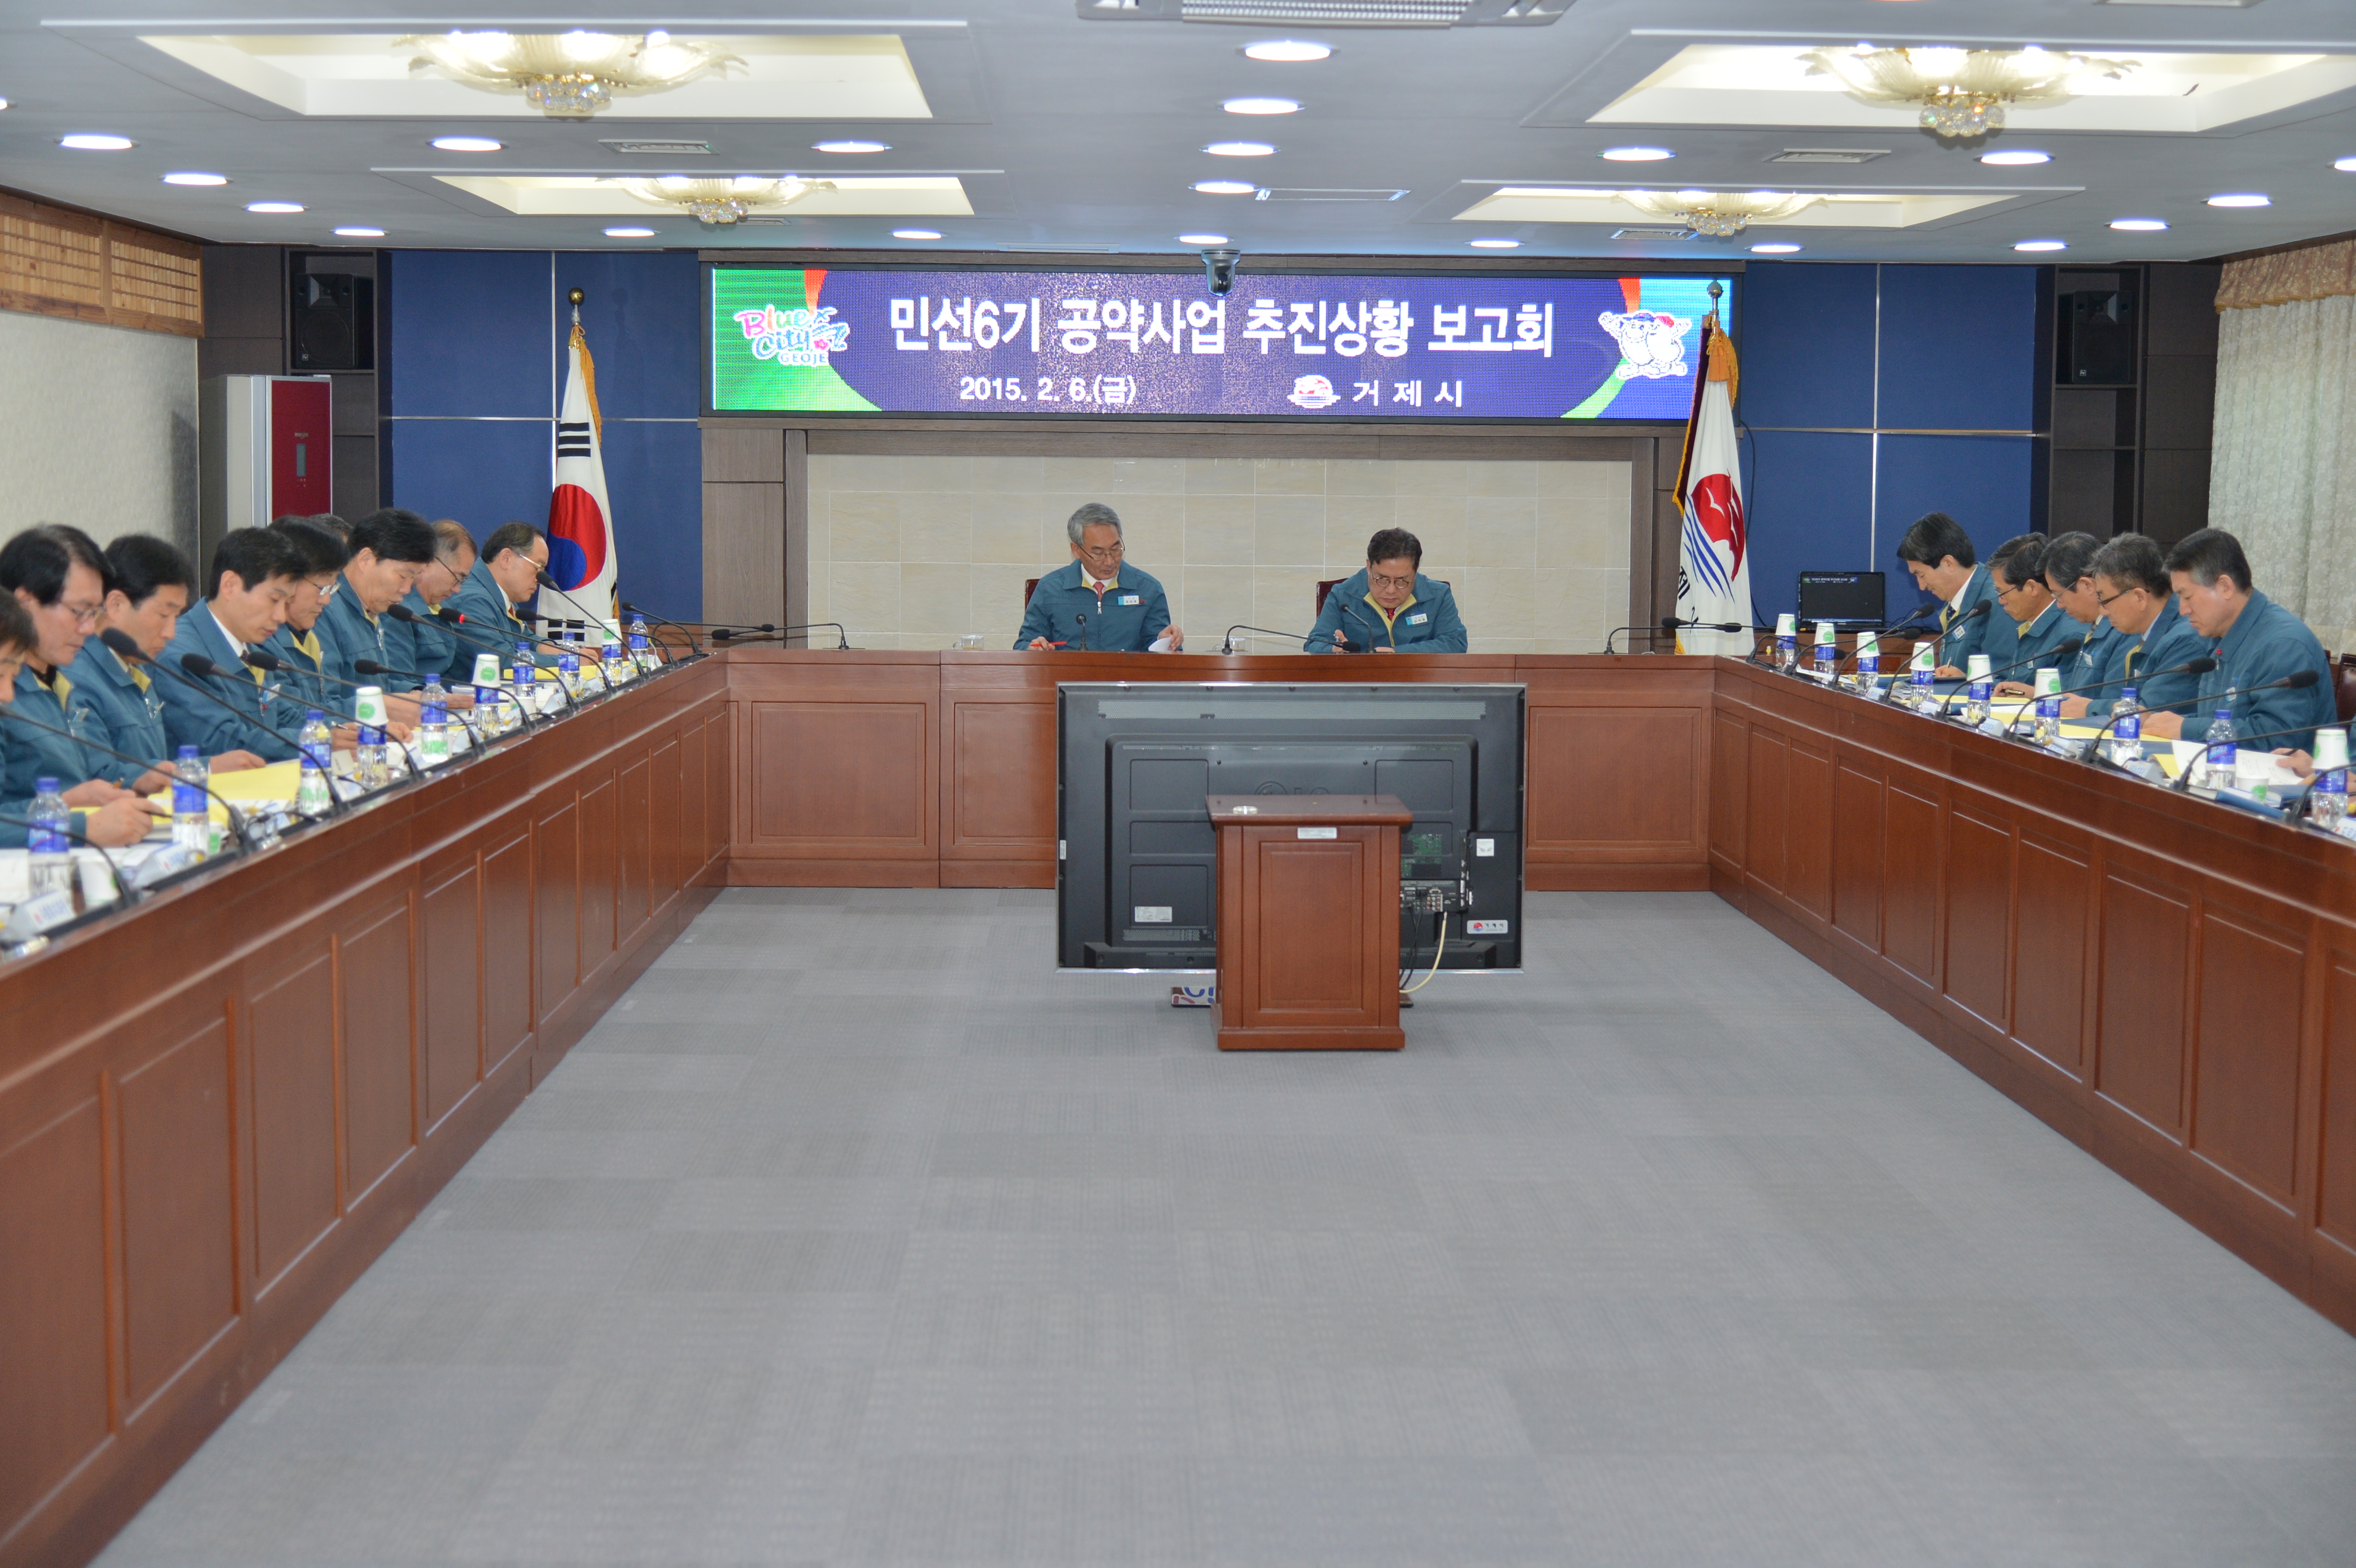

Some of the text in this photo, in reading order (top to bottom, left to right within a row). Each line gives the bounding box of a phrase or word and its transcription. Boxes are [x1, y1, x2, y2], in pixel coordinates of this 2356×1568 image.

[734, 305, 812, 338] Blue
[891, 296, 1552, 358] 민선6기 공약사업 추진상황 보고회
[753, 329, 810, 359] City
[780, 352, 829, 366] GEOJE
[960, 374, 1136, 404] 2015. 2. 6.(금)
